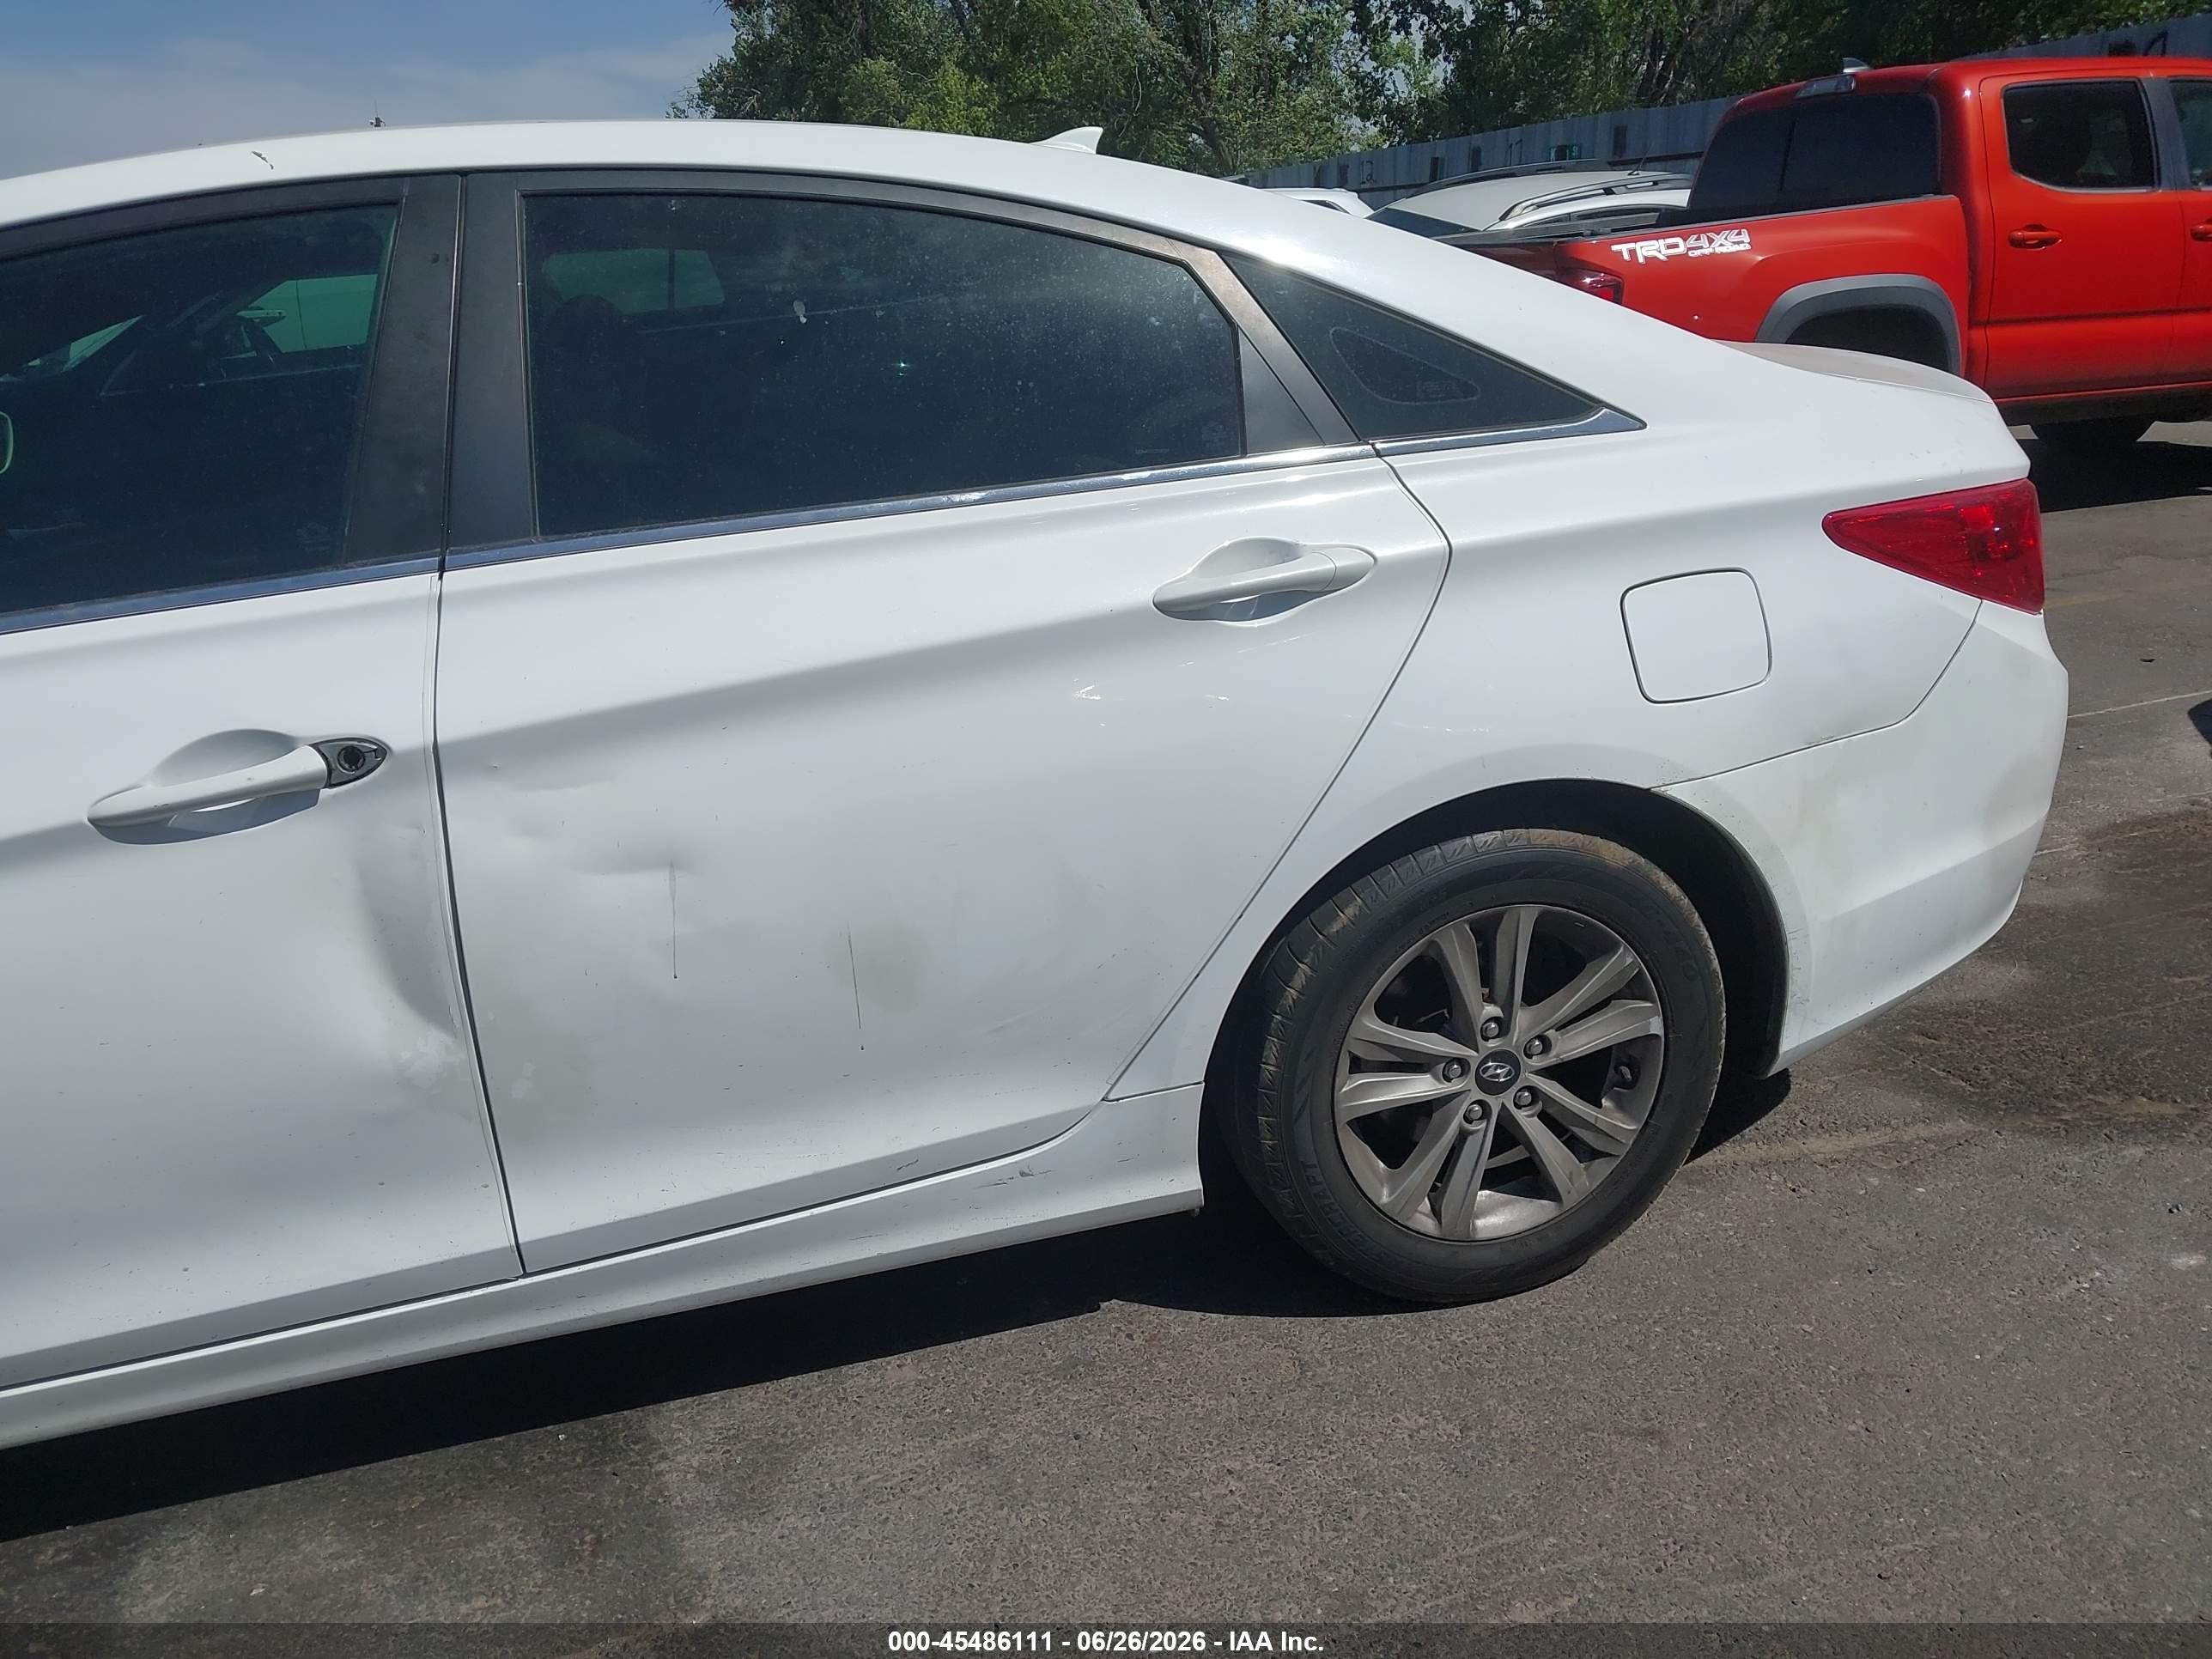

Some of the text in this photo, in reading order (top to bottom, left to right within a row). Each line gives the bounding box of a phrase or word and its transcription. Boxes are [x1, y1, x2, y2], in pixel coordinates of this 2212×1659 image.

[1611, 236, 1686, 264] TRD
[1687, 243, 1752, 258] OFF ROAD
